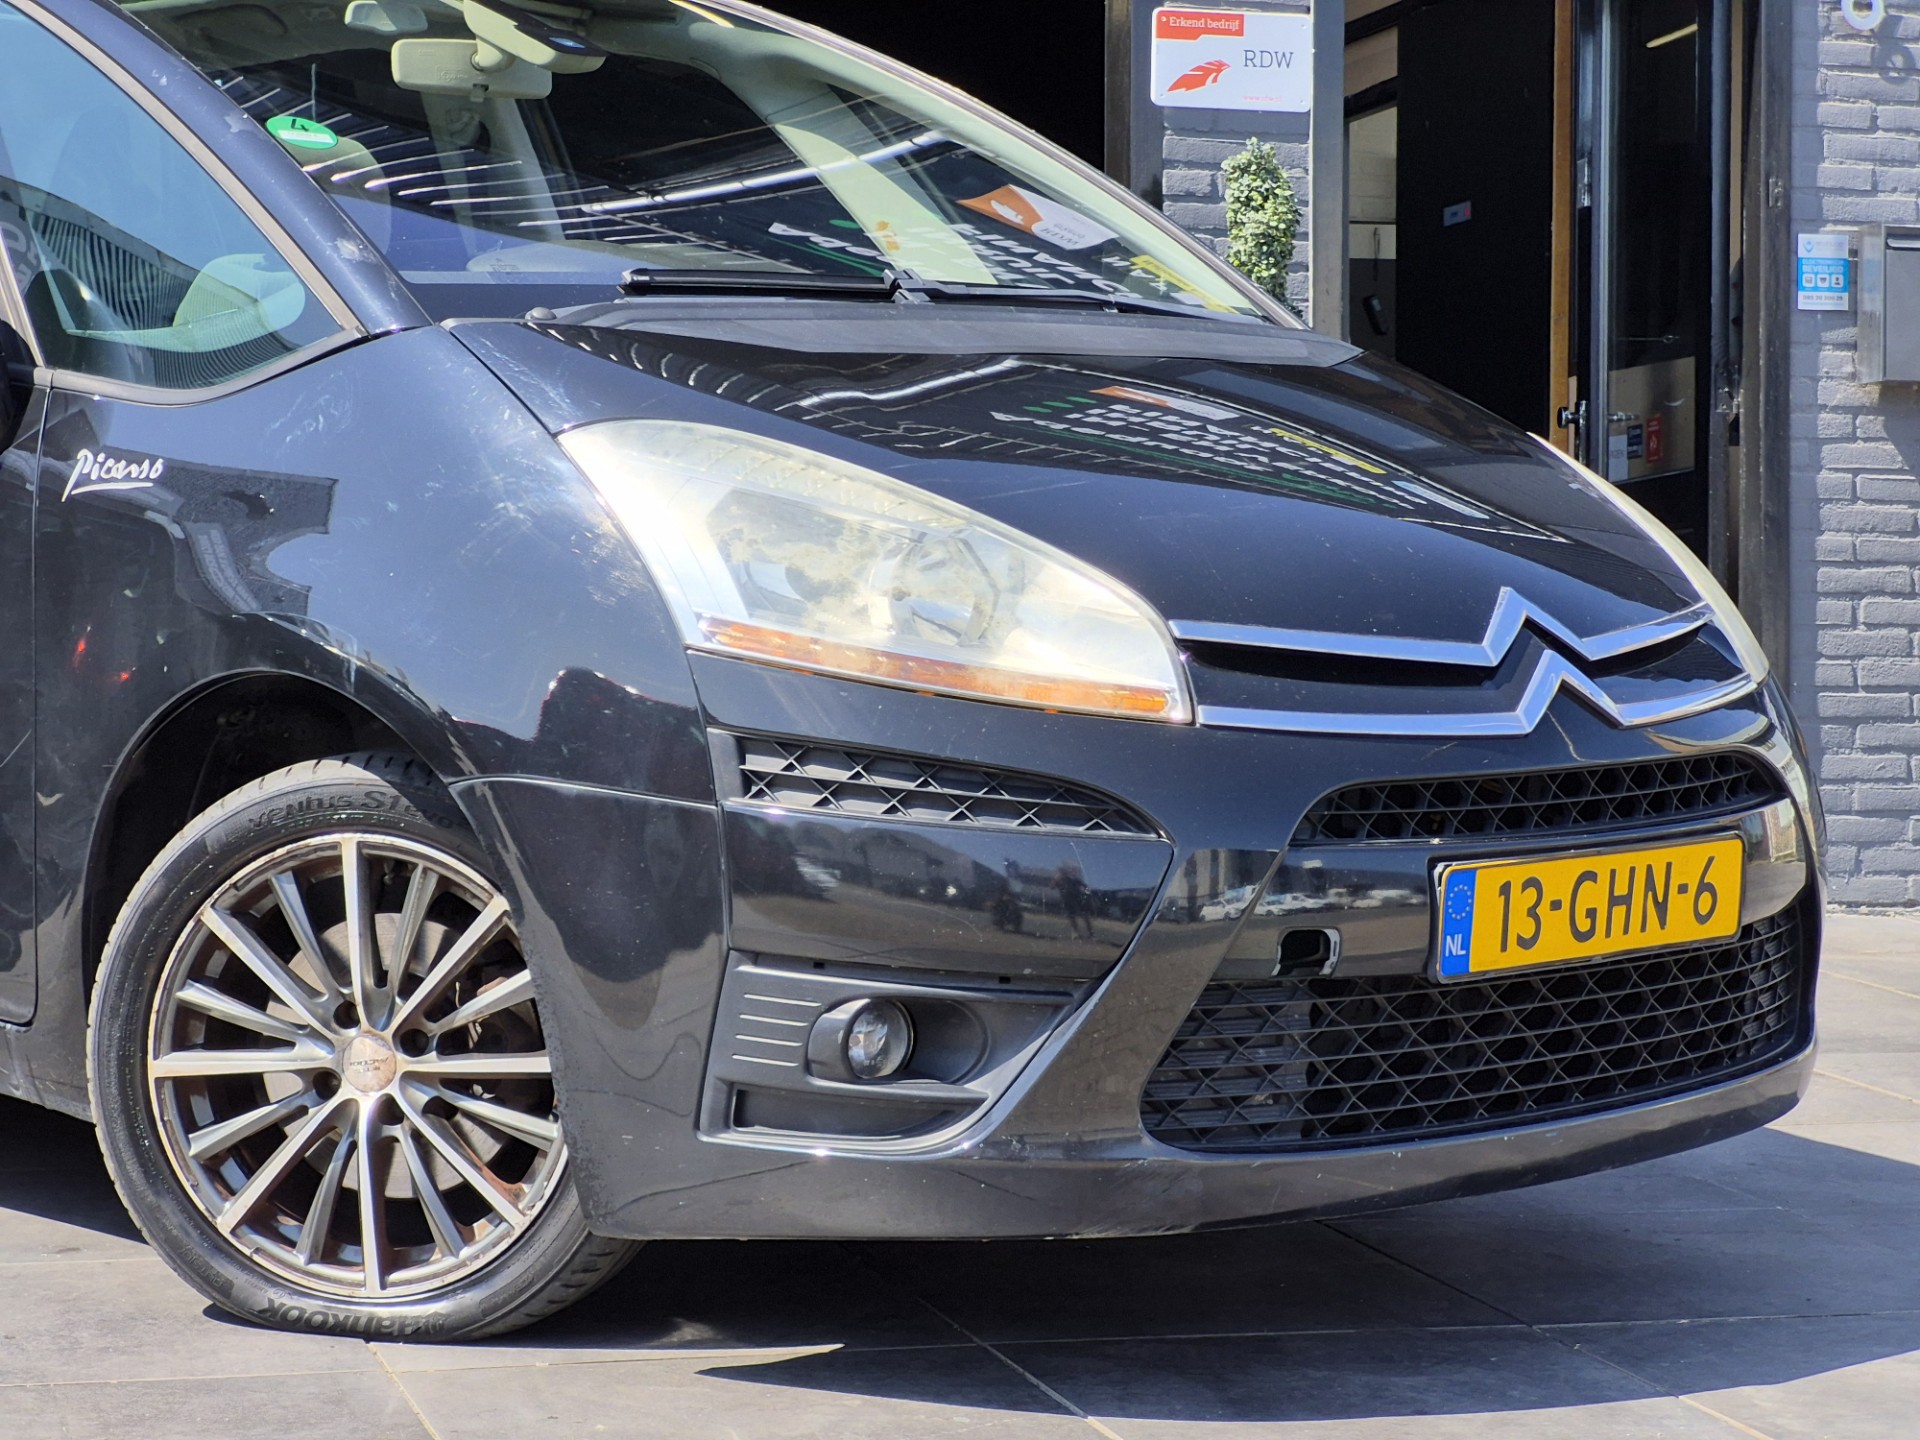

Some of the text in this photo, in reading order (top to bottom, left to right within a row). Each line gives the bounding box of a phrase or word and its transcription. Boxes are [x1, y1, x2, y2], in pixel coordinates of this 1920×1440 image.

[1169, 16, 1240, 31] Erkend bedrijf
[1243, 50, 1294, 69] RDW
[61, 448, 164, 502] Picasso
[1498, 855, 1719, 953] 13-GHN-6
[1445, 933, 1467, 958] NL
